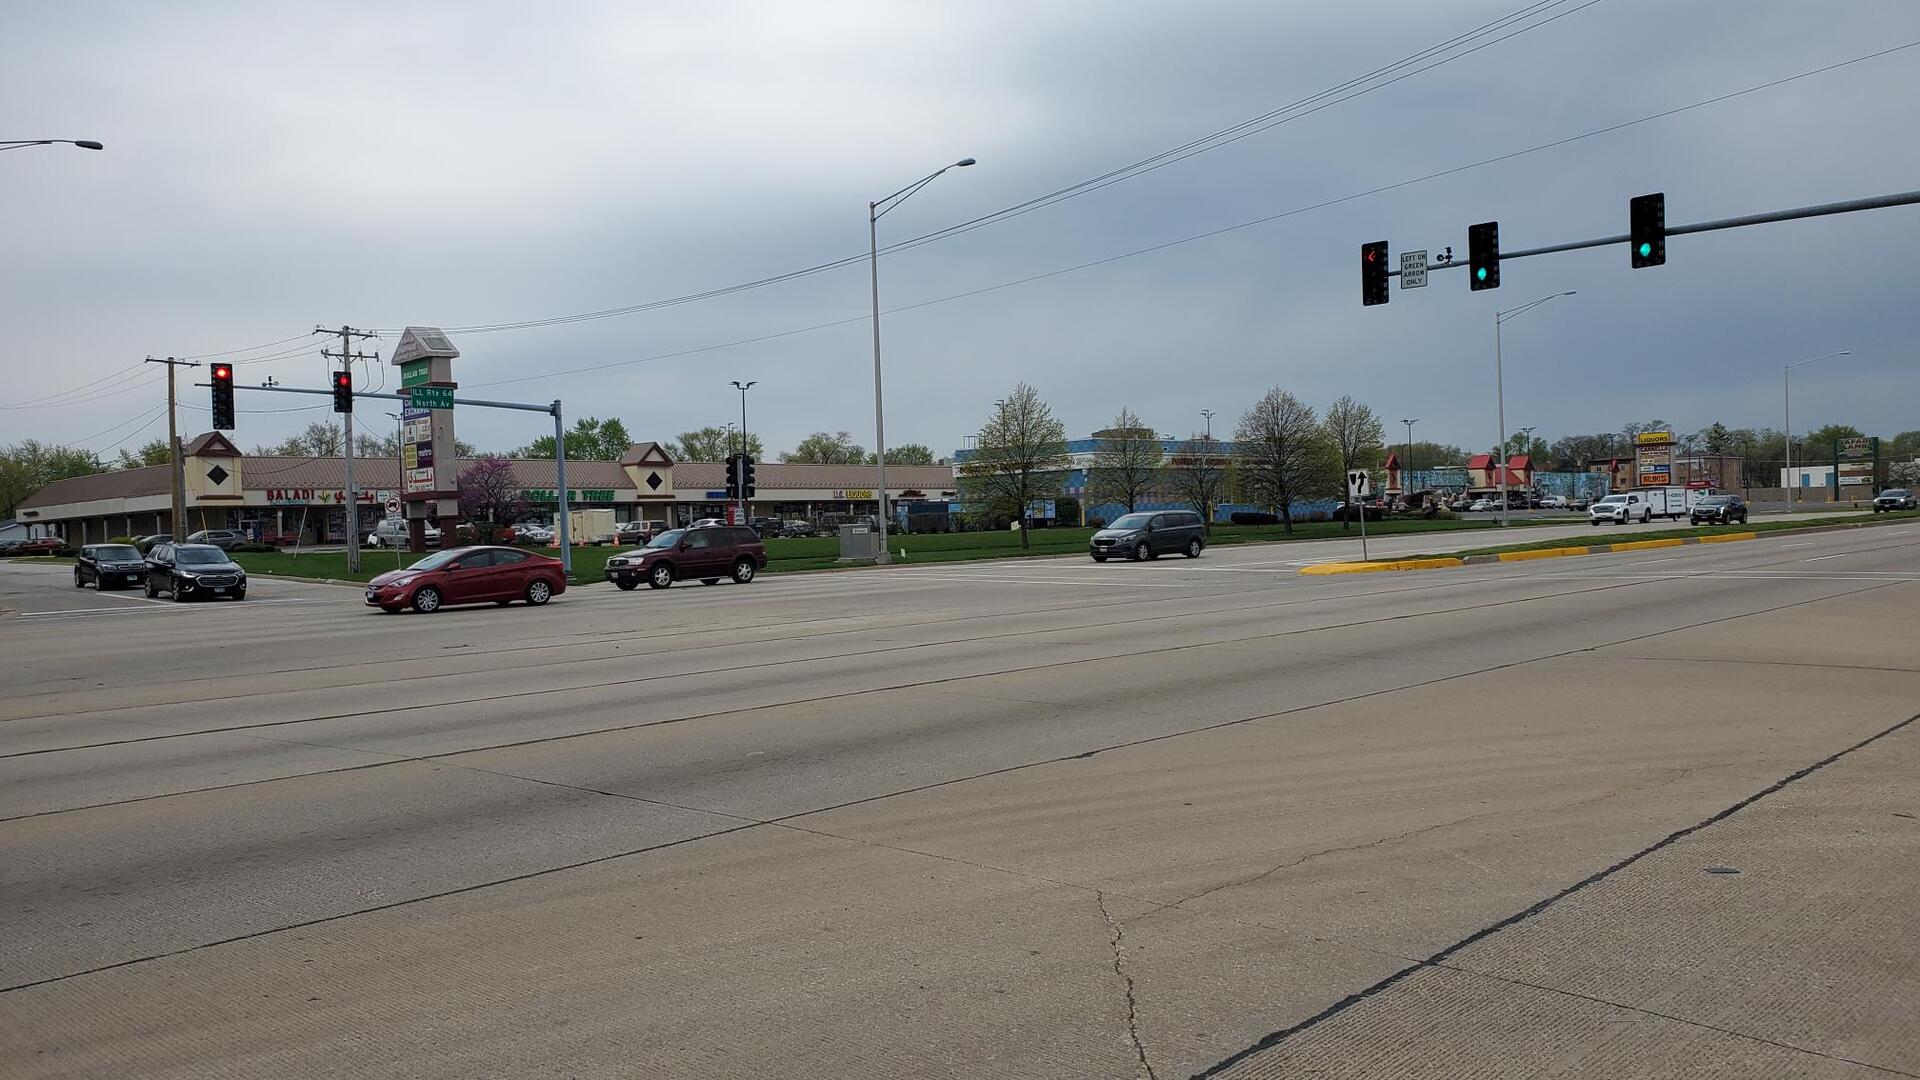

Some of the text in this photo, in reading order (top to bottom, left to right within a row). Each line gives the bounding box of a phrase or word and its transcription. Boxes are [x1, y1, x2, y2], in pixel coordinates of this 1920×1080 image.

[1404, 262, 1424, 270] GREEN
[1403, 270, 1425, 278] ARROW
[1406, 277, 1422, 286] ONLY
[403, 367, 428, 379] DOLLAR TREE
[426, 389, 440, 397] Rte
[267, 489, 315, 501] BALADI
[521, 490, 615, 501] DOLLR TREE
[845, 490, 873, 499] LIQUORS
